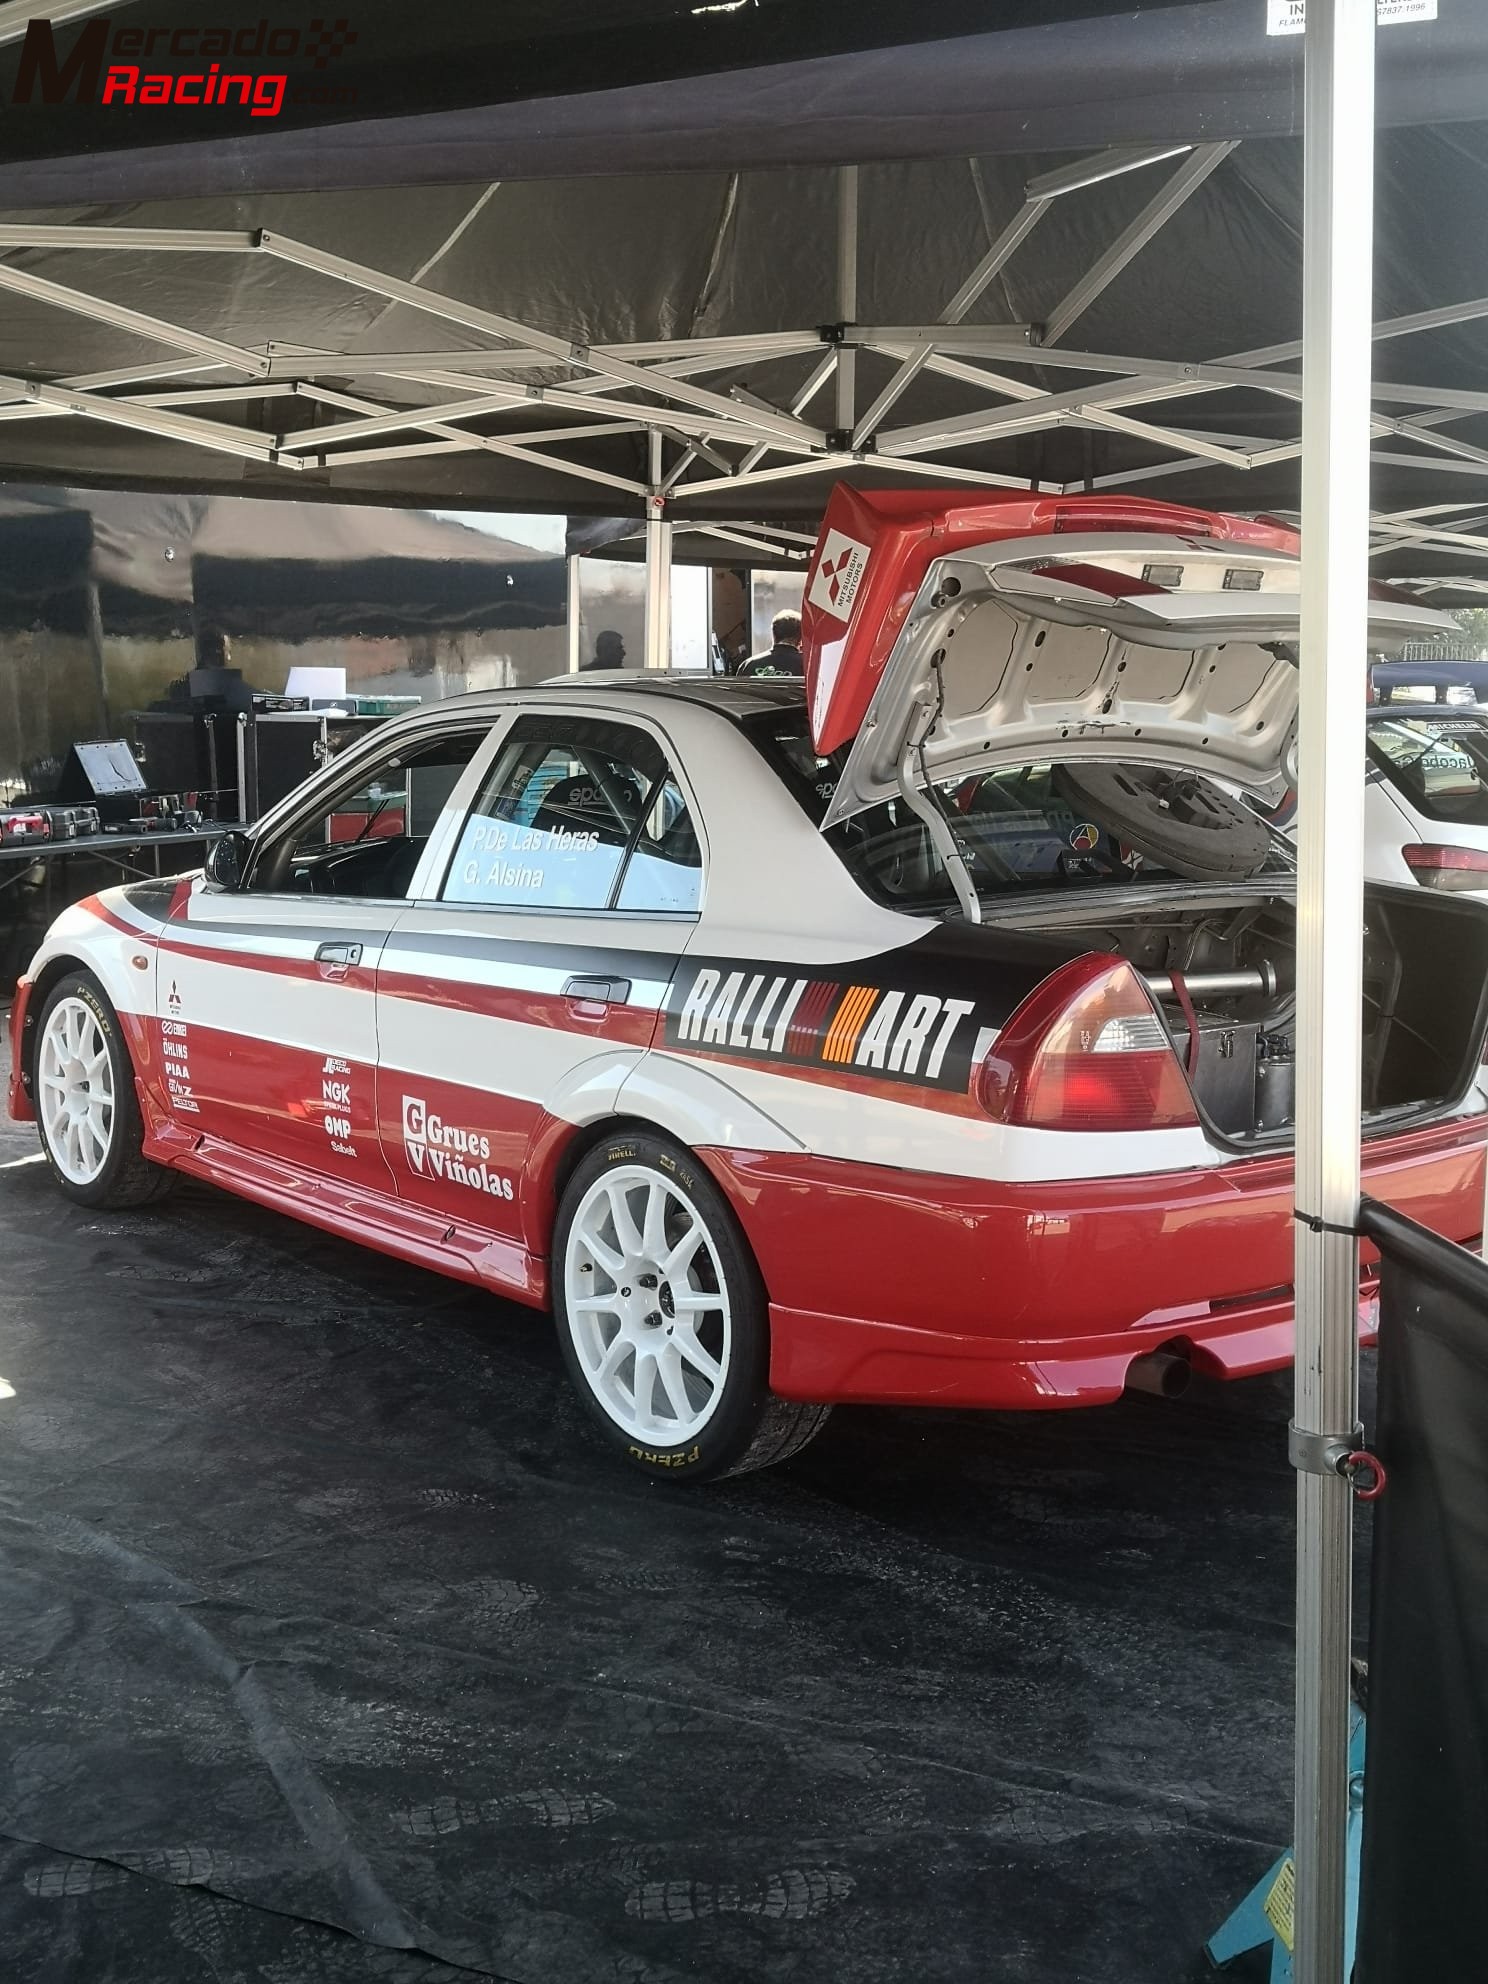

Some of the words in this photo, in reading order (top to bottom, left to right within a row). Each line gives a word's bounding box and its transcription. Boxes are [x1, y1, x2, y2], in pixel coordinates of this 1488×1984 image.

[838, 552, 859, 607] MITSUBISHI
[846, 563, 863, 604] MOTORS
[512, 829, 543, 851] Las
[546, 825, 600, 852] Heras
[463, 863, 481, 884] G.
[486, 862, 544, 888] Alsina
[164, 1061, 190, 1080] PIAA
[322, 1079, 351, 1105] NGK
[324, 1114, 352, 1140] OMP
[427, 1115, 490, 1159] Grues
[330, 1141, 358, 1158] Sabelt
[608, 1146, 637, 1161] PIRELL
[428, 1148, 514, 1201] Viñolas
